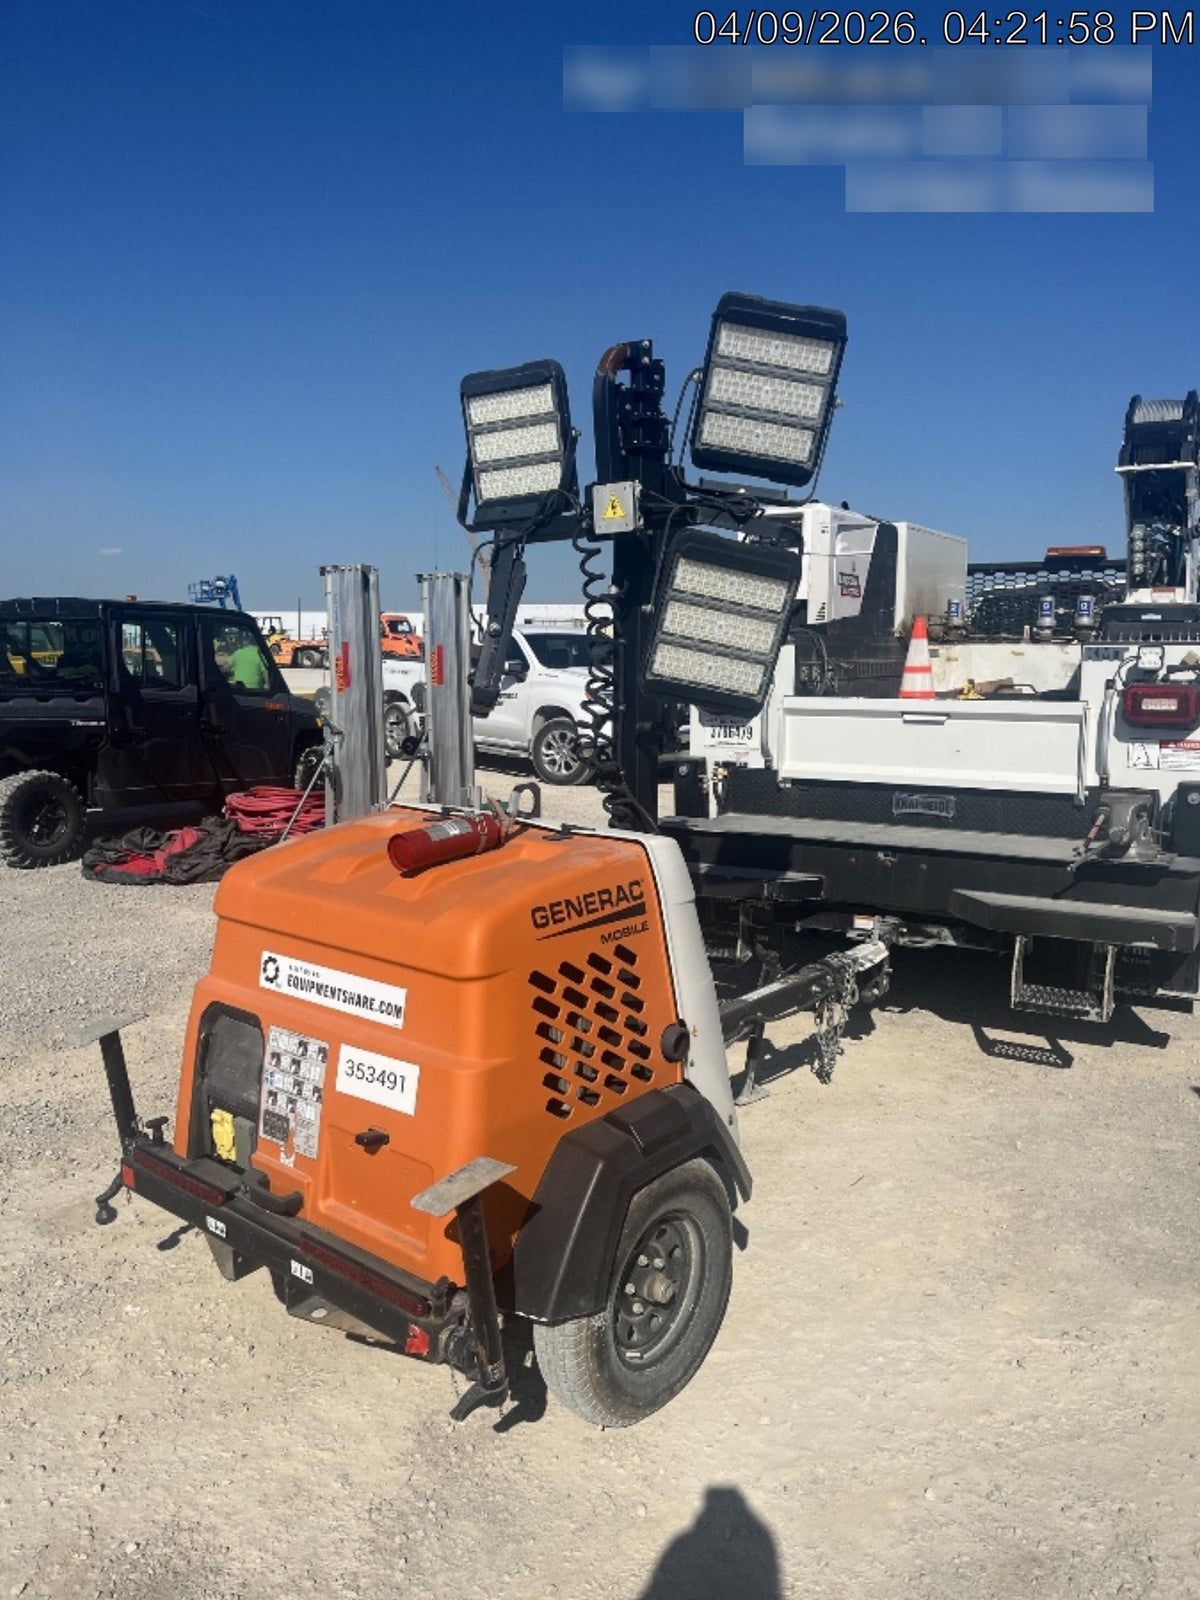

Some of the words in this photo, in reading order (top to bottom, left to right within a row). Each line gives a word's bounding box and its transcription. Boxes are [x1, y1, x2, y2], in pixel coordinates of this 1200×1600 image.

[531, 879, 645, 930] GENERAC
[600, 920, 650, 944] MOBILE
[287, 973, 402, 1019] EQUIPMENTSHARE.COM
[344, 1058, 407, 1094] 353491
